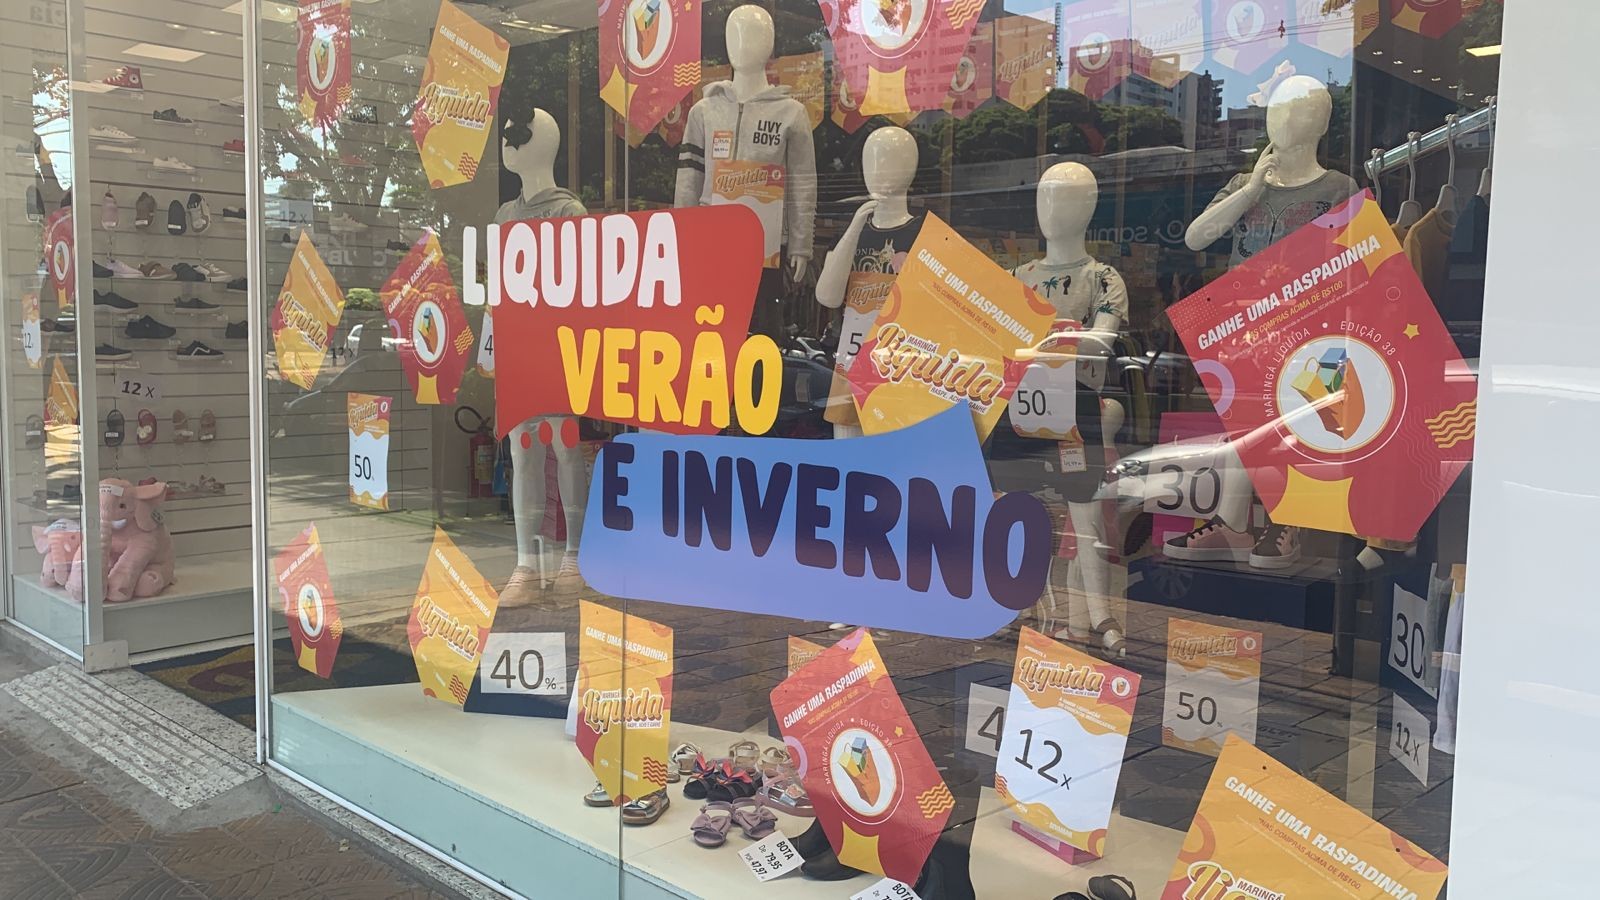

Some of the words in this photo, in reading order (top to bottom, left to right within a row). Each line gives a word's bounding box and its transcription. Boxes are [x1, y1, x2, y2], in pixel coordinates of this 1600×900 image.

[753, 132, 780, 146] BOYS
[758, 120, 782, 134] LIVY
[463, 211, 682, 309] LIQUIDA
[917, 248, 944, 279] GANHE
[944, 270, 968, 296] UMA
[967, 287, 1036, 345] RASPADINHA
[1198, 312, 1246, 350] GANHE
[1246, 292, 1280, 322] UMA
[1282, 235, 1382, 302] RASPADINHA
[1258, 312, 1290, 334] COMPRAS
[1290, 298, 1311, 316] ACIMA
[1311, 294, 1320, 304] DE
[484, 334, 494, 356] 4
[907, 335, 938, 354] MARINGÁ
[1340, 320, 1382, 343] EDIÇÃO
[1382, 342, 1396, 356] 38
[556, 304, 783, 436] VERÃO
[871, 323, 1005, 407] Liquida
[122, 380, 142, 396] 12
[1157, 464, 1220, 514] 30
[602, 442, 634, 532] E
[662, 450, 1053, 610] INVERNO
[450, 567, 460, 583] UMA
[418, 596, 480, 658] Liquida
[586, 626, 606, 642] GANHE
[606, 634, 622, 648] UMA
[624, 636, 668, 663] RASPADINHA
[1394, 612, 1425, 680] 30
[490, 649, 556, 690] 40%
[1020, 658, 1104, 693] Liquida
[584, 688, 664, 734] Liquida
[784, 704, 808, 728] GANHE
[807, 692, 826, 712] UMA
[825, 659, 876, 701] RASPADINHA
[978, 706, 1004, 751] 4
[1396, 722, 1410, 756] 12
[776, 840, 794, 861] BOTA
[1224, 776, 1276, 814] GANHE
[1276, 809, 1312, 840] UMA
[1312, 833, 1418, 900] RASPADINHA
[1274, 828, 1306, 853] COMPRAS
[1305, 850, 1328, 868] ACIMA
[1328, 864, 1338, 876] DE
[750, 860, 768, 877] 47,97
[764, 852, 783, 870] 79,95
